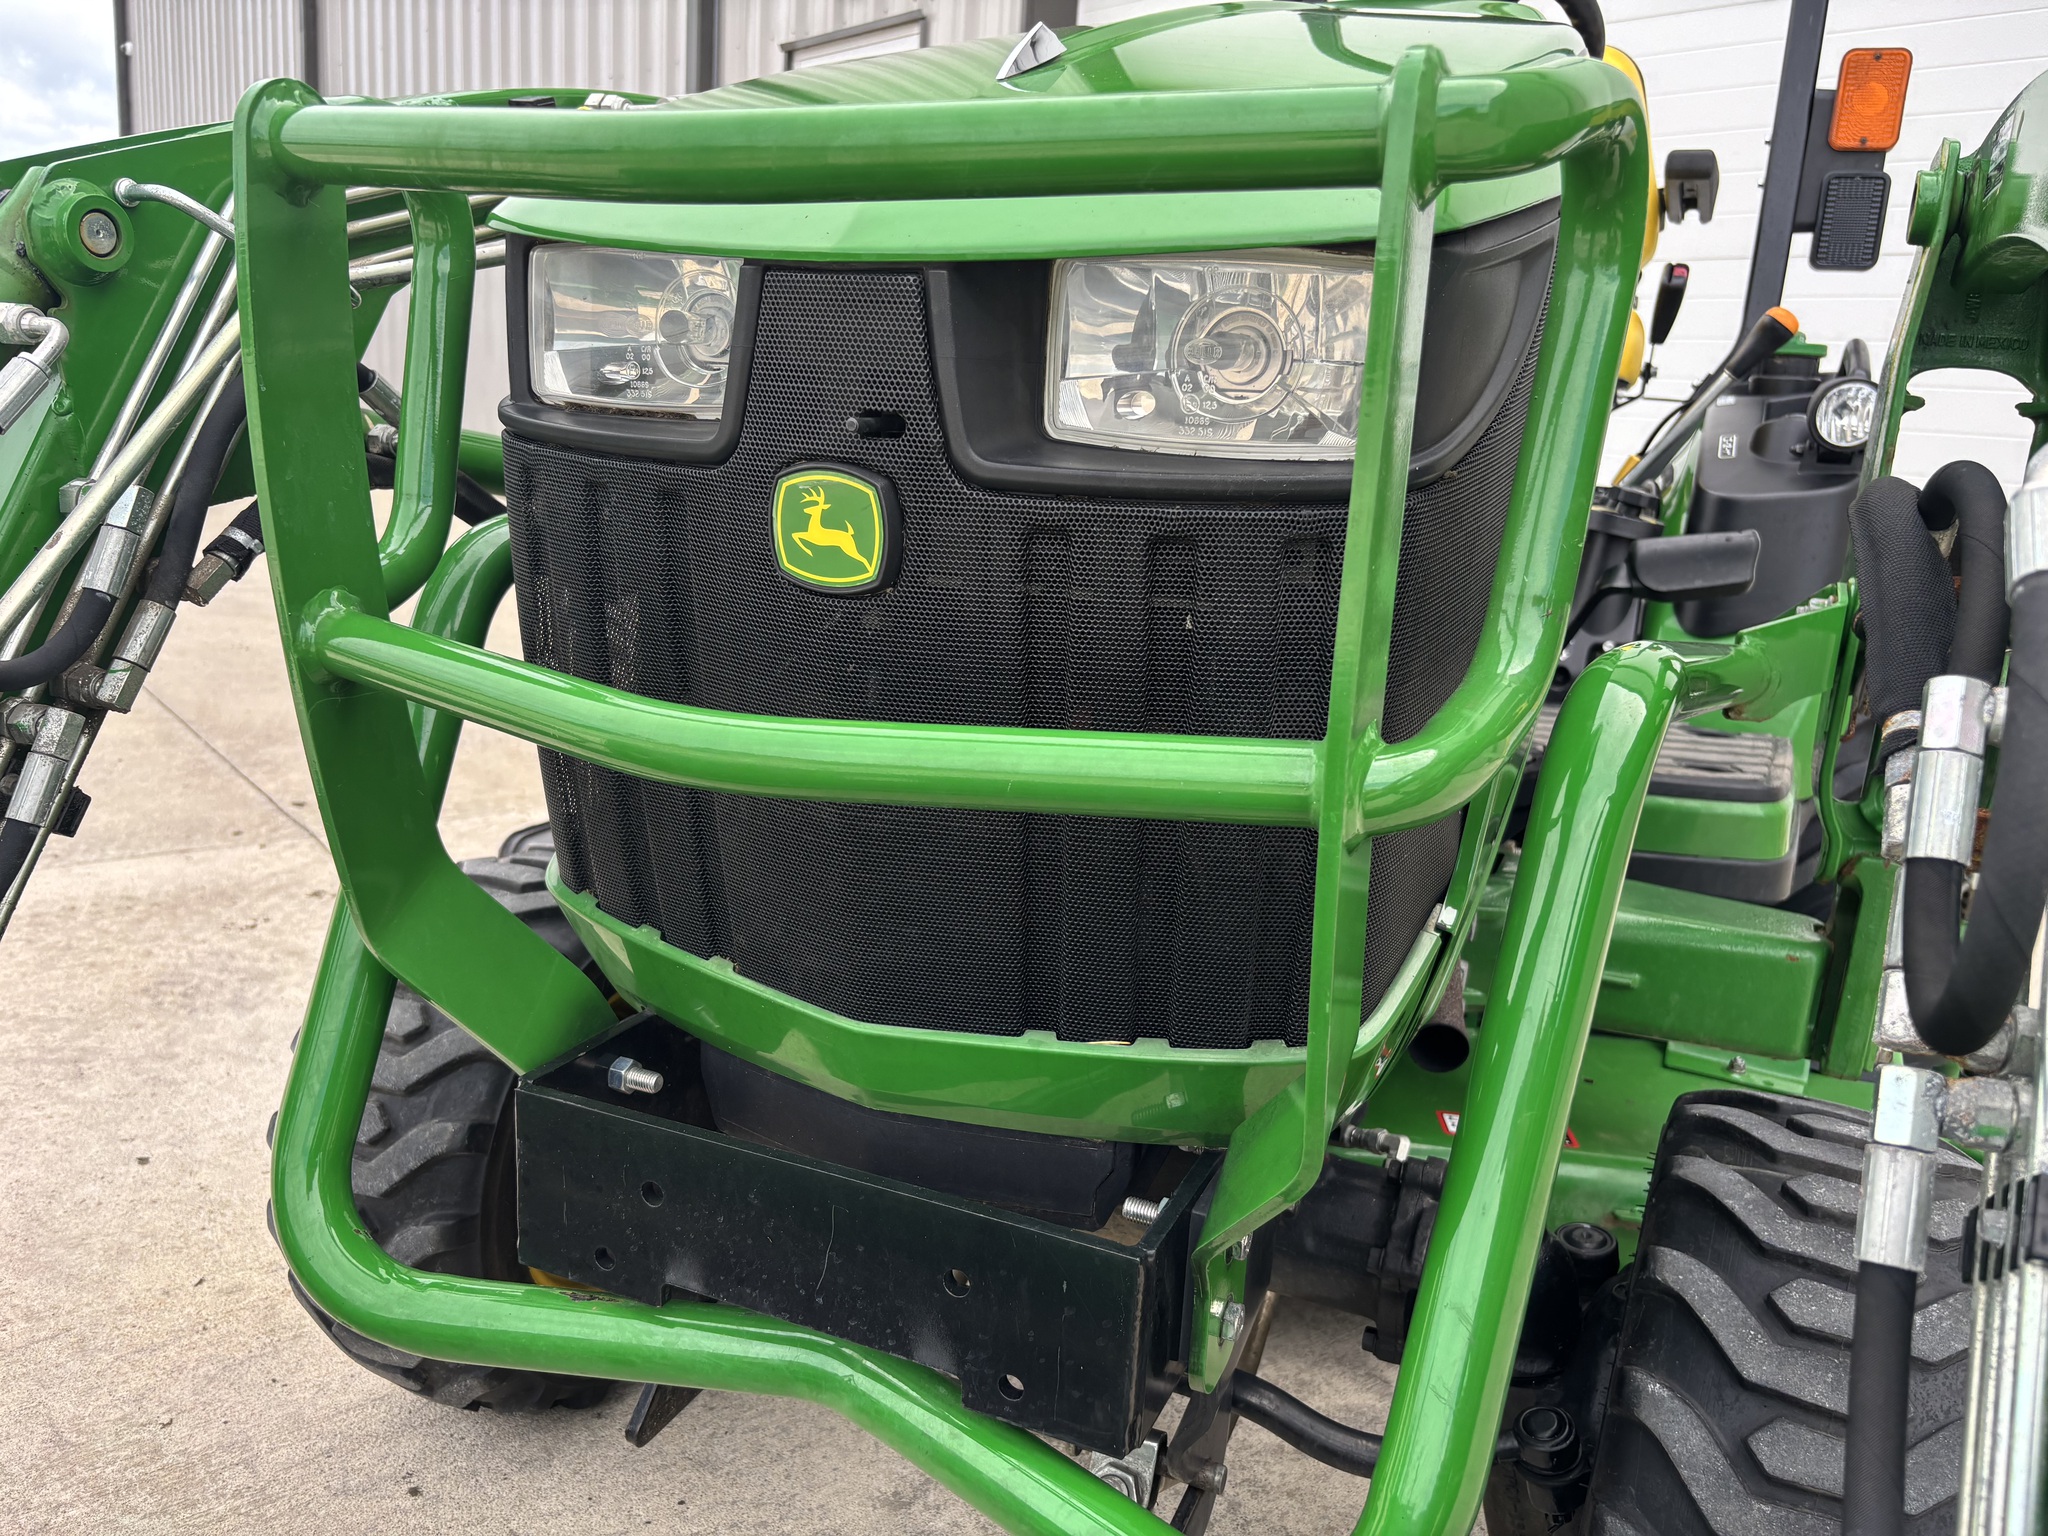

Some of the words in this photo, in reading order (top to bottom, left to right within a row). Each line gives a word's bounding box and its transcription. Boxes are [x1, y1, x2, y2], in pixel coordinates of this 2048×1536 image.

[1918, 332, 1956, 348] MADE
[1959, 334, 1974, 349] IN
[1975, 334, 2029, 351] MEXICO
[1181, 383, 1193, 392] 02
